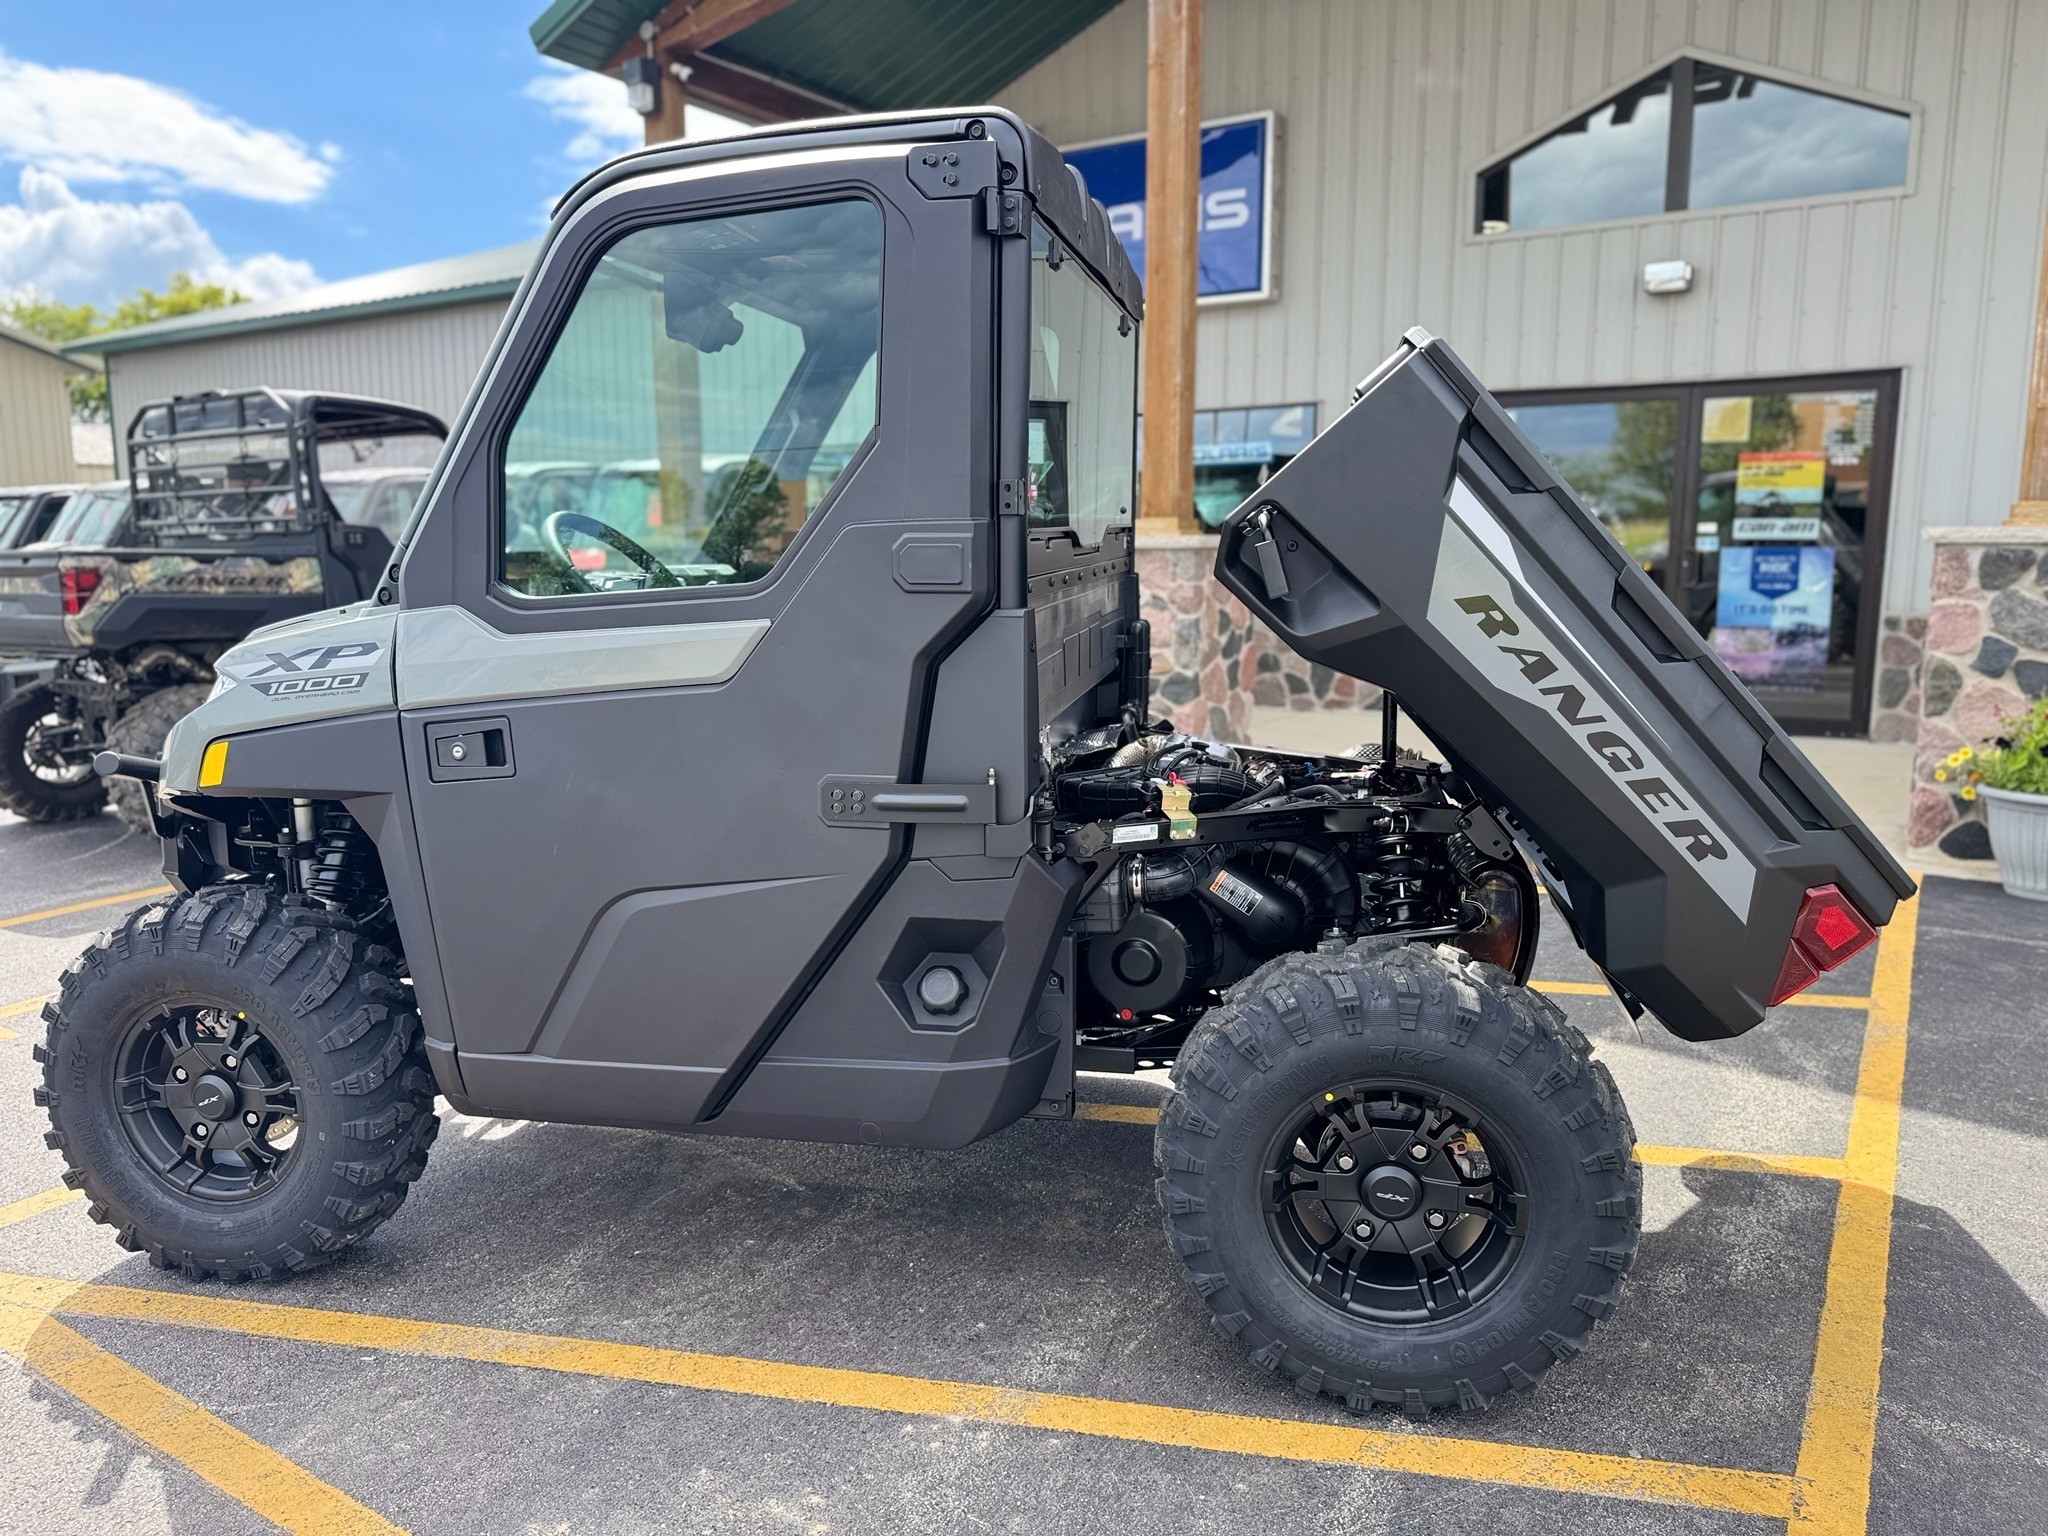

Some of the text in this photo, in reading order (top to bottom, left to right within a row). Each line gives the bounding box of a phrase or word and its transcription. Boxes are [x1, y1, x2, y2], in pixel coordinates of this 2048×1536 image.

[166, 575, 285, 587] RANGER
[245, 642, 380, 679] XP
[268, 674, 361, 695] 1000
[295, 691, 340, 700] OVERHEAD
[1453, 594, 1728, 862] RANGER
[267, 1010, 313, 1076] ARMOR
[1365, 1045, 1446, 1068] MRF
[198, 1094, 220, 1107] XP
[1221, 1055, 1335, 1171] X-TERRAIN
[74, 1117, 164, 1228] X-TERRAIN
[1376, 1192, 1410, 1203] XP
[1470, 1250, 1572, 1358] PRO ARMOR
